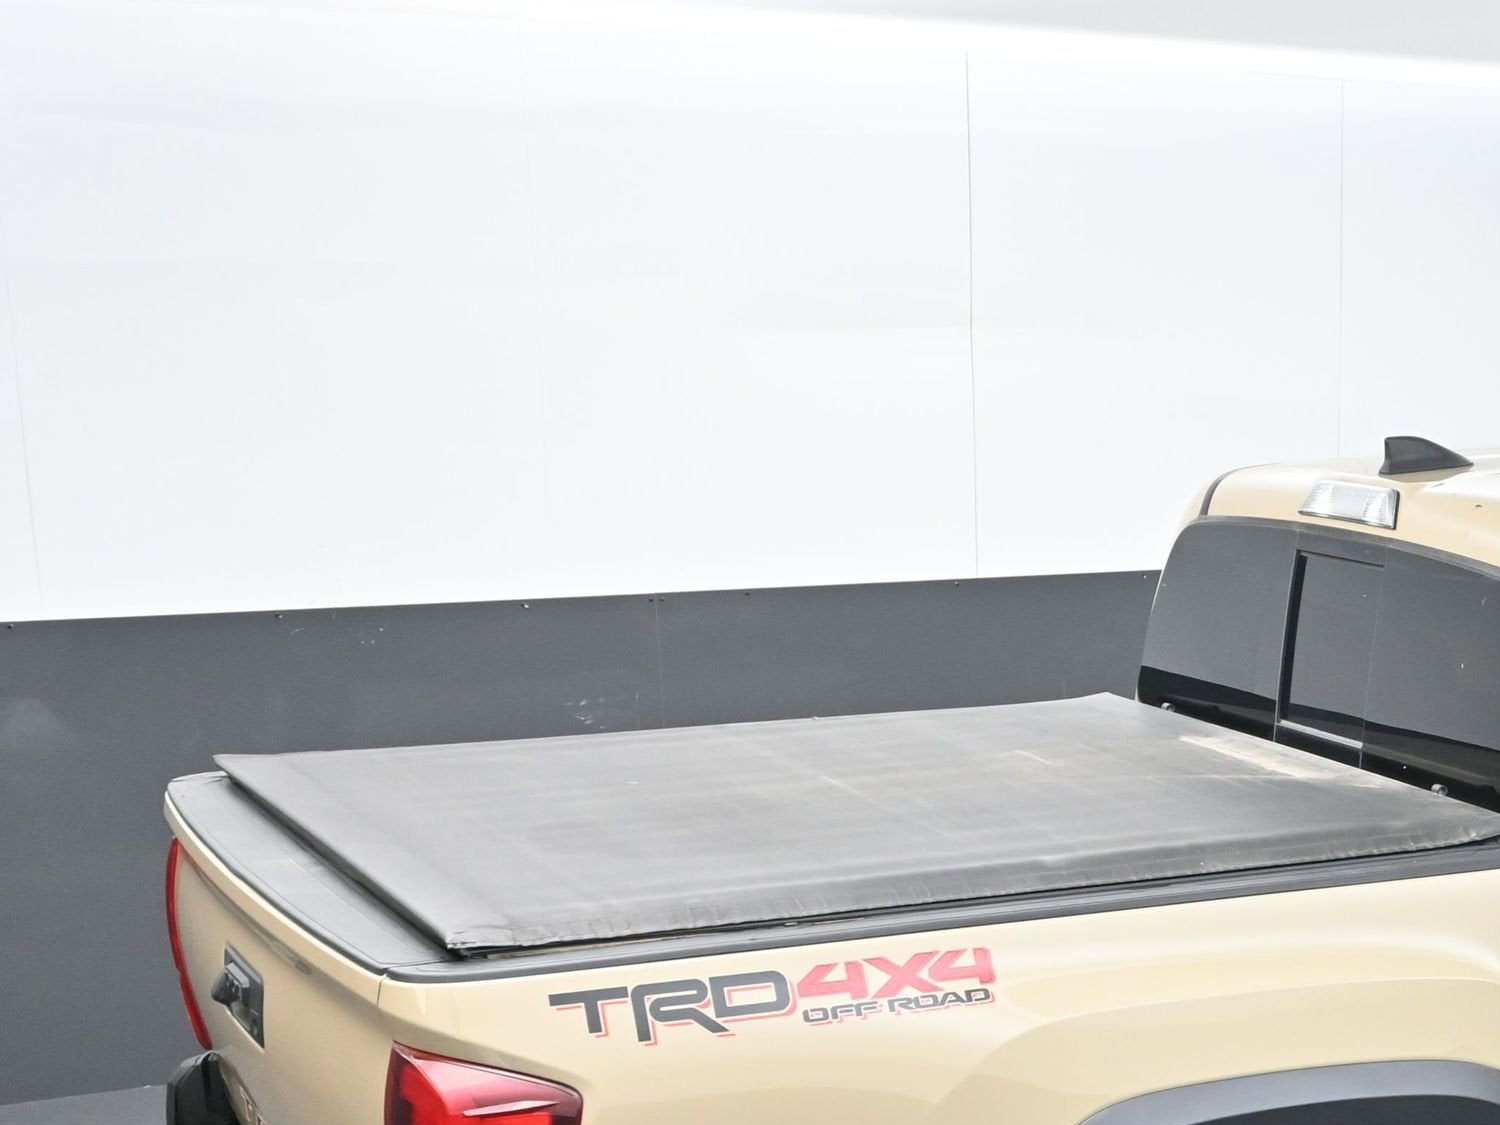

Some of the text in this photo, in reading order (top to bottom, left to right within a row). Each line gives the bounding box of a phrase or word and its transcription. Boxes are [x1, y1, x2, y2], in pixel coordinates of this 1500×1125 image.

[548, 946, 997, 1047] TRD 4X4
[802, 987, 995, 1025] OFF ROAD
